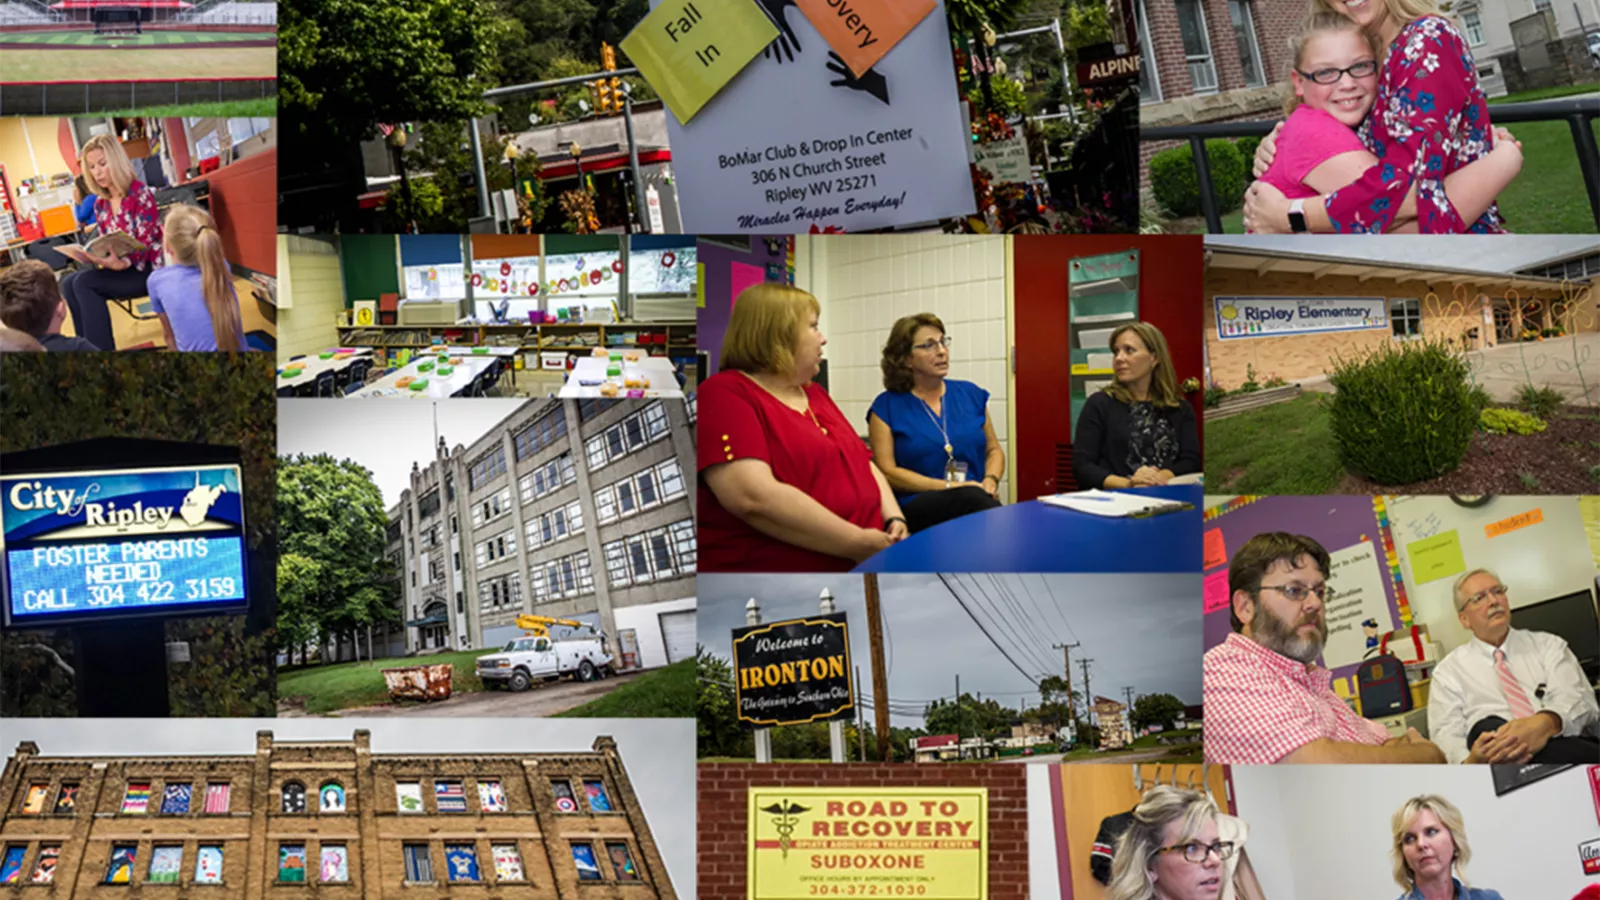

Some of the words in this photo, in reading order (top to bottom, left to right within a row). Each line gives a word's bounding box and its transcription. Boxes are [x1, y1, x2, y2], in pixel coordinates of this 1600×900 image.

[664, 2, 703, 43] Fall
[695, 43, 721, 67] In
[718, 151, 762, 169] BoMar
[765, 144, 797, 162] Club
[800, 142, 811, 156] &
[812, 139, 847, 154] Drop
[850, 134, 864, 147] In
[866, 128, 913, 146] Center
[751, 169, 777, 184] 306
[779, 166, 790, 180] N
[793, 158, 842, 177] Church
[846, 152, 886, 170] Street
[765, 187, 807, 204] Ripley
[808, 180, 833, 196] WV
[836, 174, 877, 193] 25271
[737, 211, 790, 229] Miracles
[792, 206, 840, 221] Happen
[844, 191, 907, 215] Everyday!
[1244, 305, 1294, 322] Ripley
[1298, 304, 1371, 321] Elementary
[10, 481, 75, 515] City
[68, 483, 100, 517] of
[85, 501, 175, 529] Ripley
[33, 543, 110, 568] FOSTER
[121, 538, 208, 562] PARENTS
[86, 562, 161, 585] NEEDED
[23, 589, 75, 610] CALL
[87, 585, 125, 606] 304
[137, 582, 175, 601] 422
[186, 577, 235, 599] 3159
[755, 637, 809, 653] Welcome
[811, 634, 824, 645] to
[740, 655, 844, 690] IRONTON
[740, 697, 756, 710] The
[796, 690, 830, 705] Southern
[830, 686, 849, 699] Ohio
[826, 801, 908, 816] ROAD
[920, 801, 959, 816] TO
[812, 821, 973, 837] RECOVERY
[810, 855, 925, 869] SUBOXONE
[810, 885, 926, 895] 304-372-1030
